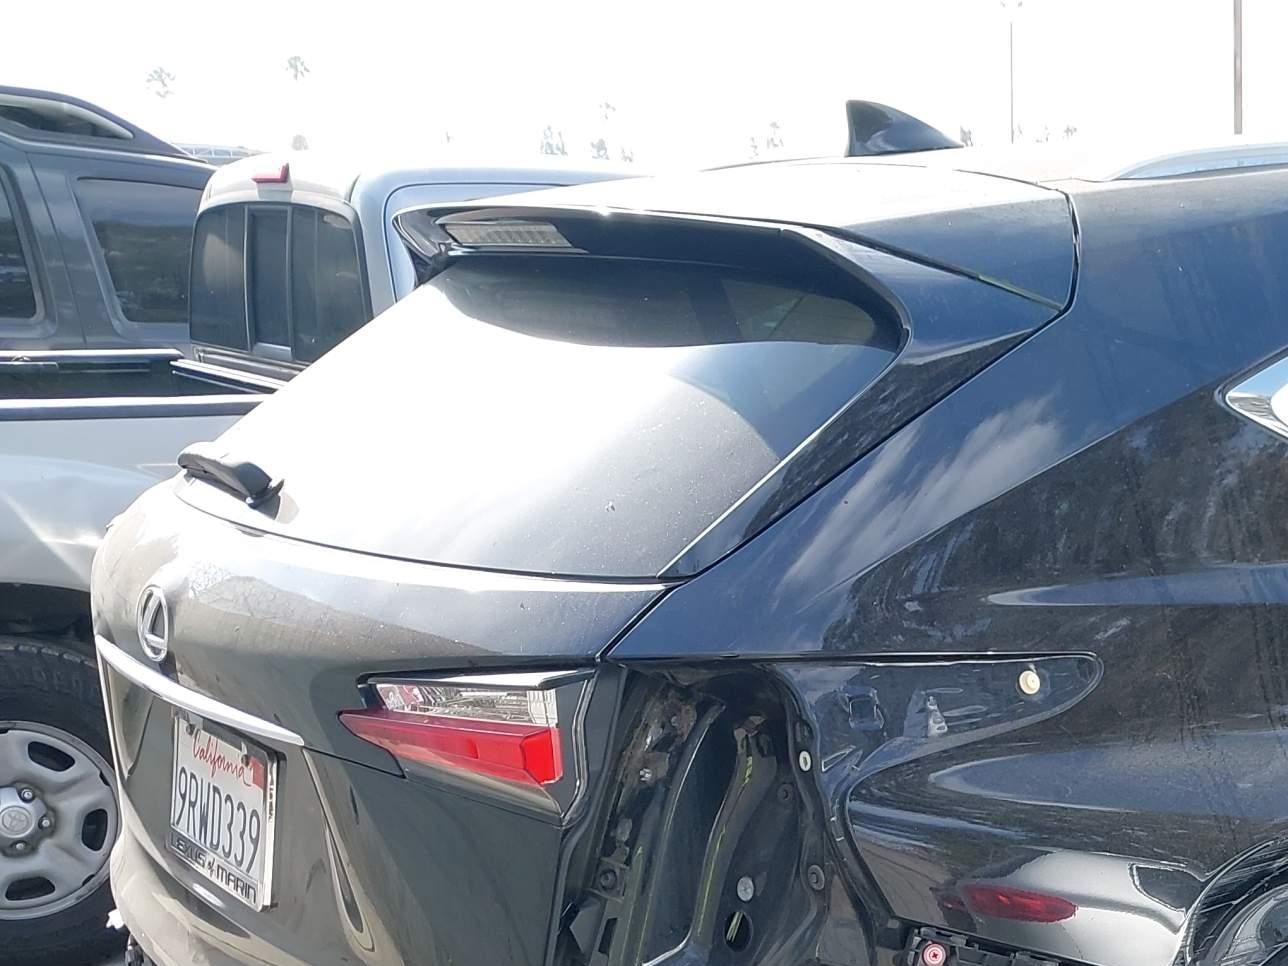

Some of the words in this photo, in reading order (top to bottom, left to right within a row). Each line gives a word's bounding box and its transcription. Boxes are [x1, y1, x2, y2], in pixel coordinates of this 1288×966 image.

[192, 730, 251, 787] California
[176, 766, 261, 874] 9RWD339
[170, 831, 207, 869] LEXUS
[216, 863, 257, 905] MARIN
